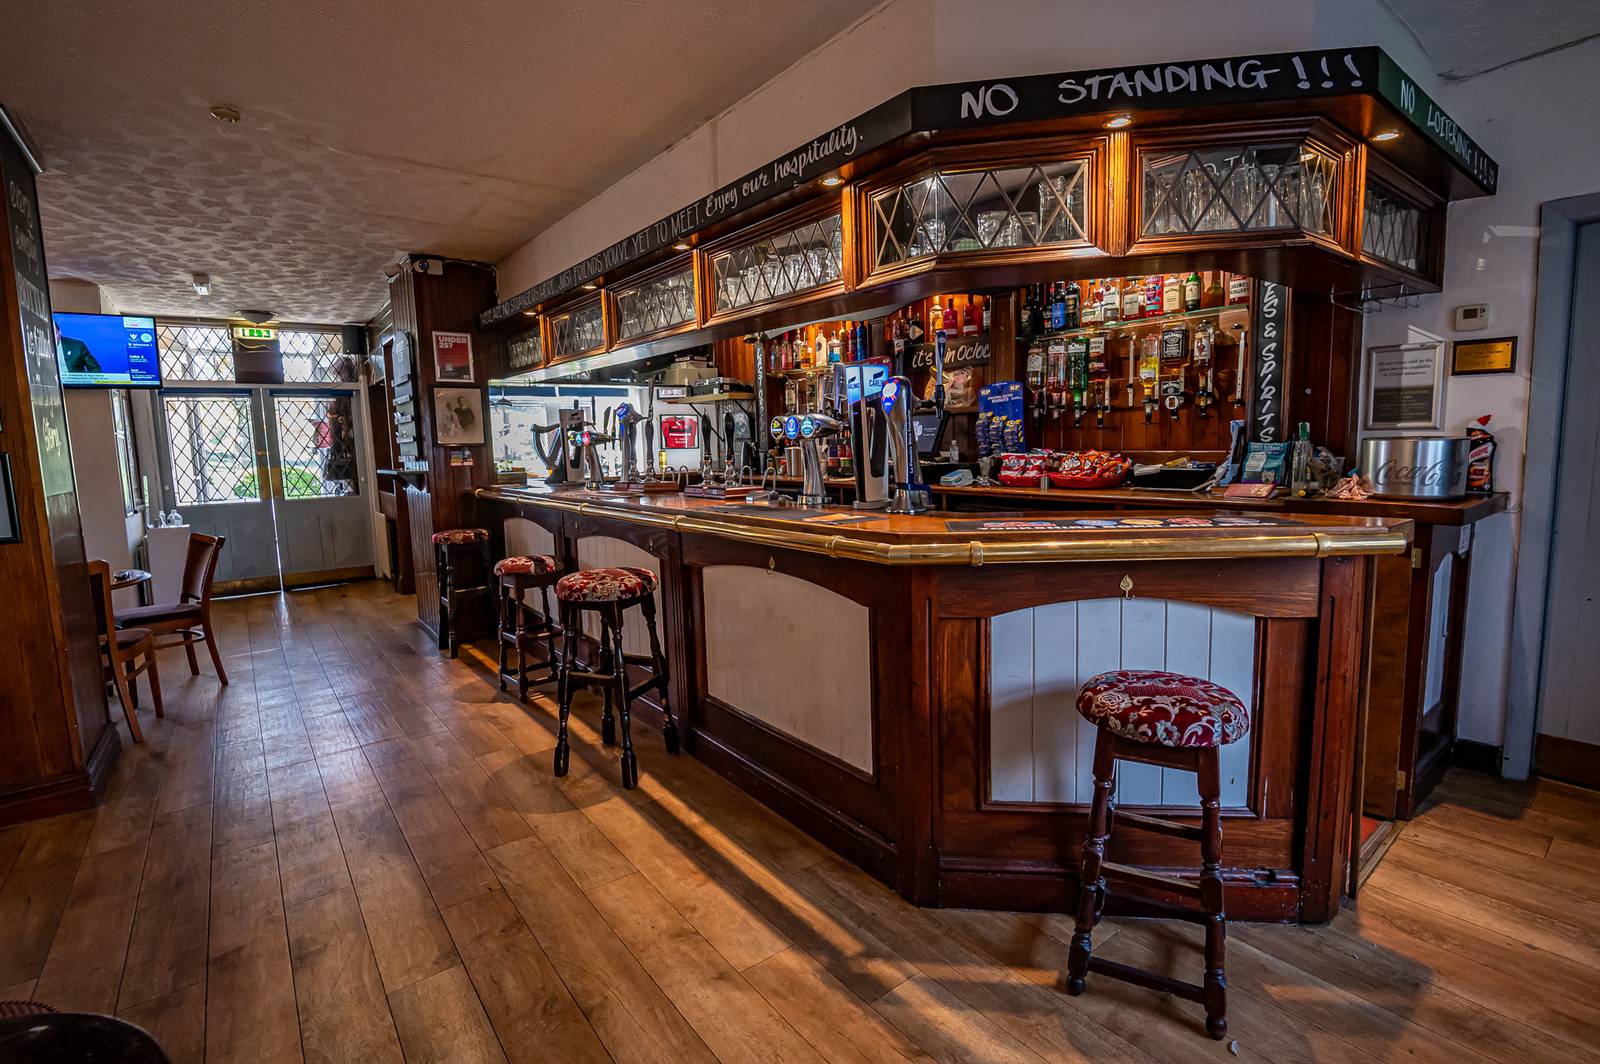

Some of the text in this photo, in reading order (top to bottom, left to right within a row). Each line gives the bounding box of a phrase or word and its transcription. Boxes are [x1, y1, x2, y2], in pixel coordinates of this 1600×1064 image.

[961, 84, 1019, 119] NO
[1058, 60, 1281, 104] STANDING
[1401, 79, 1416, 115] NO
[1427, 104, 1472, 166] LOITERING
[705, 124, 863, 217] Enjoy our hospitality.
[632, 228, 651, 255] YET
[655, 220, 668, 244] TO
[671, 202, 704, 239] MEET.
[438, 336, 467, 344] UNDER
[912, 341, 991, 369] it's in O'cloc
[1263, 322, 1277, 339] &
[1257, 342, 1278, 443] SPIRITS
